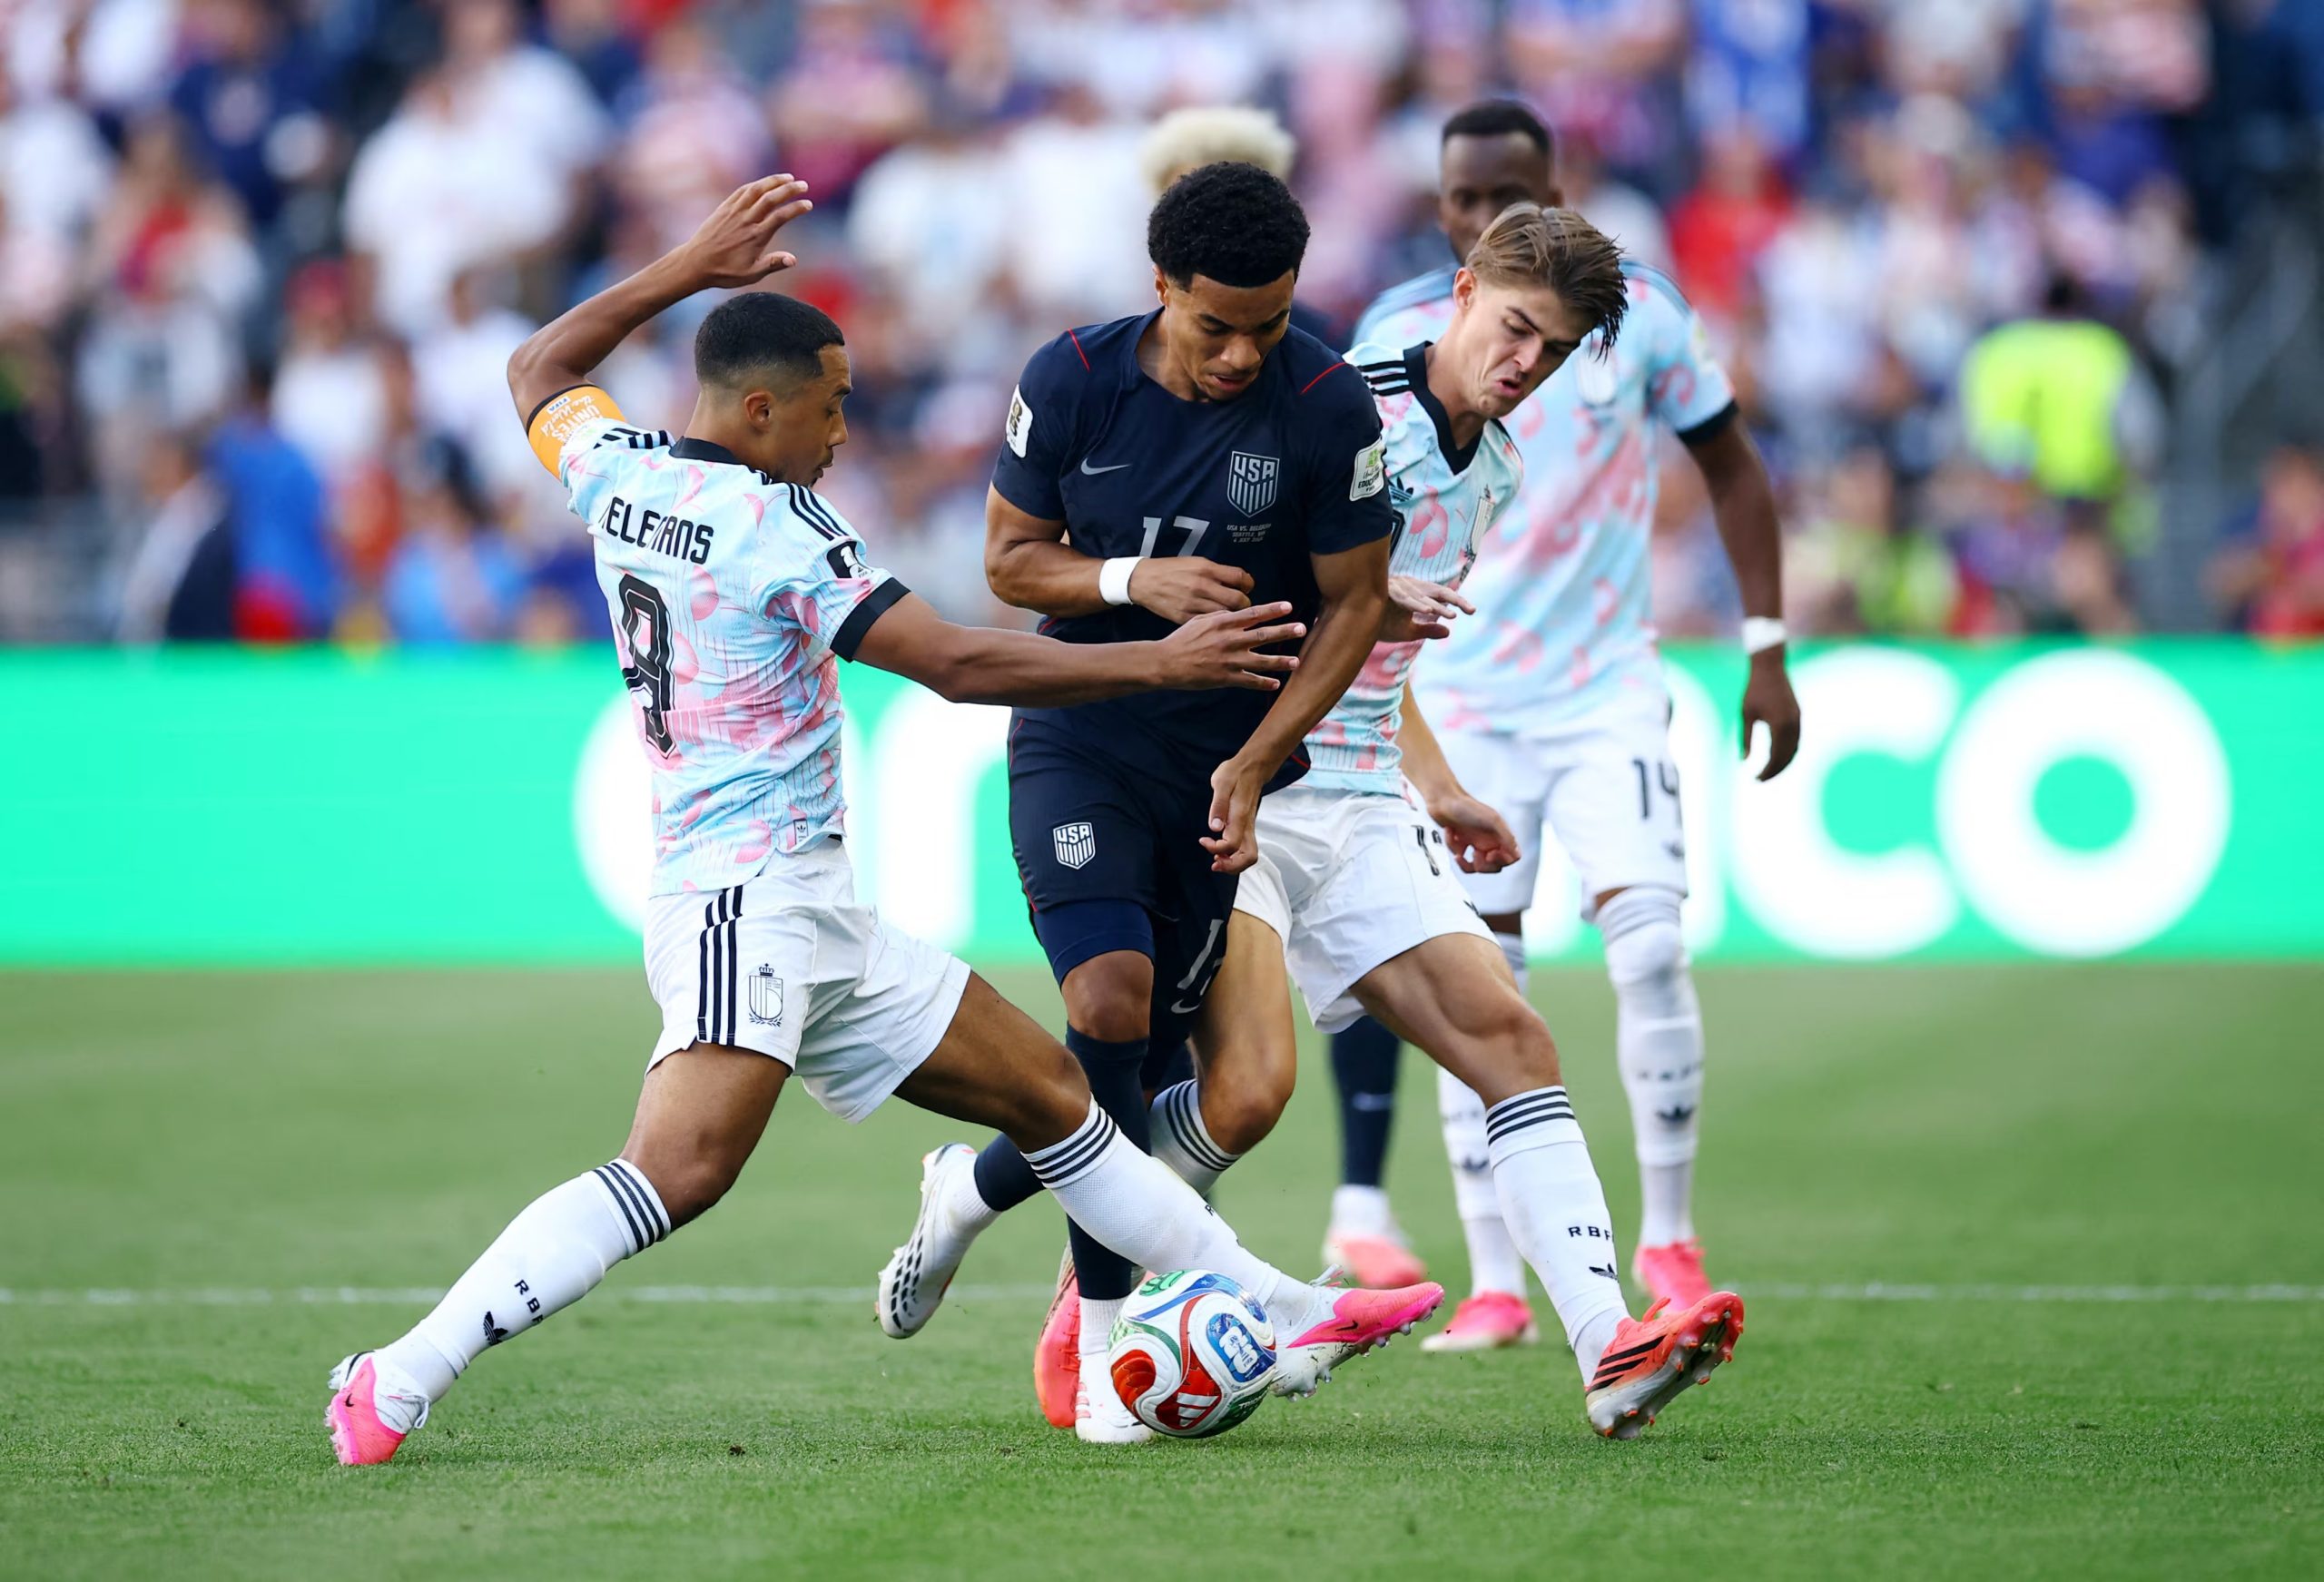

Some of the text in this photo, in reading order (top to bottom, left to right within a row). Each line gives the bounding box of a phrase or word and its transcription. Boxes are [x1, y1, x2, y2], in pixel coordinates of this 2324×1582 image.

[552, 405, 600, 442] UNITES
[1235, 456, 1275, 483] USA
[599, 496, 714, 565] ELEANS
[1139, 516, 1210, 558] 17
[1057, 825, 1090, 844] USA
[1569, 1226, 1610, 1241] RBF
[515, 1279, 544, 1325] RBF
